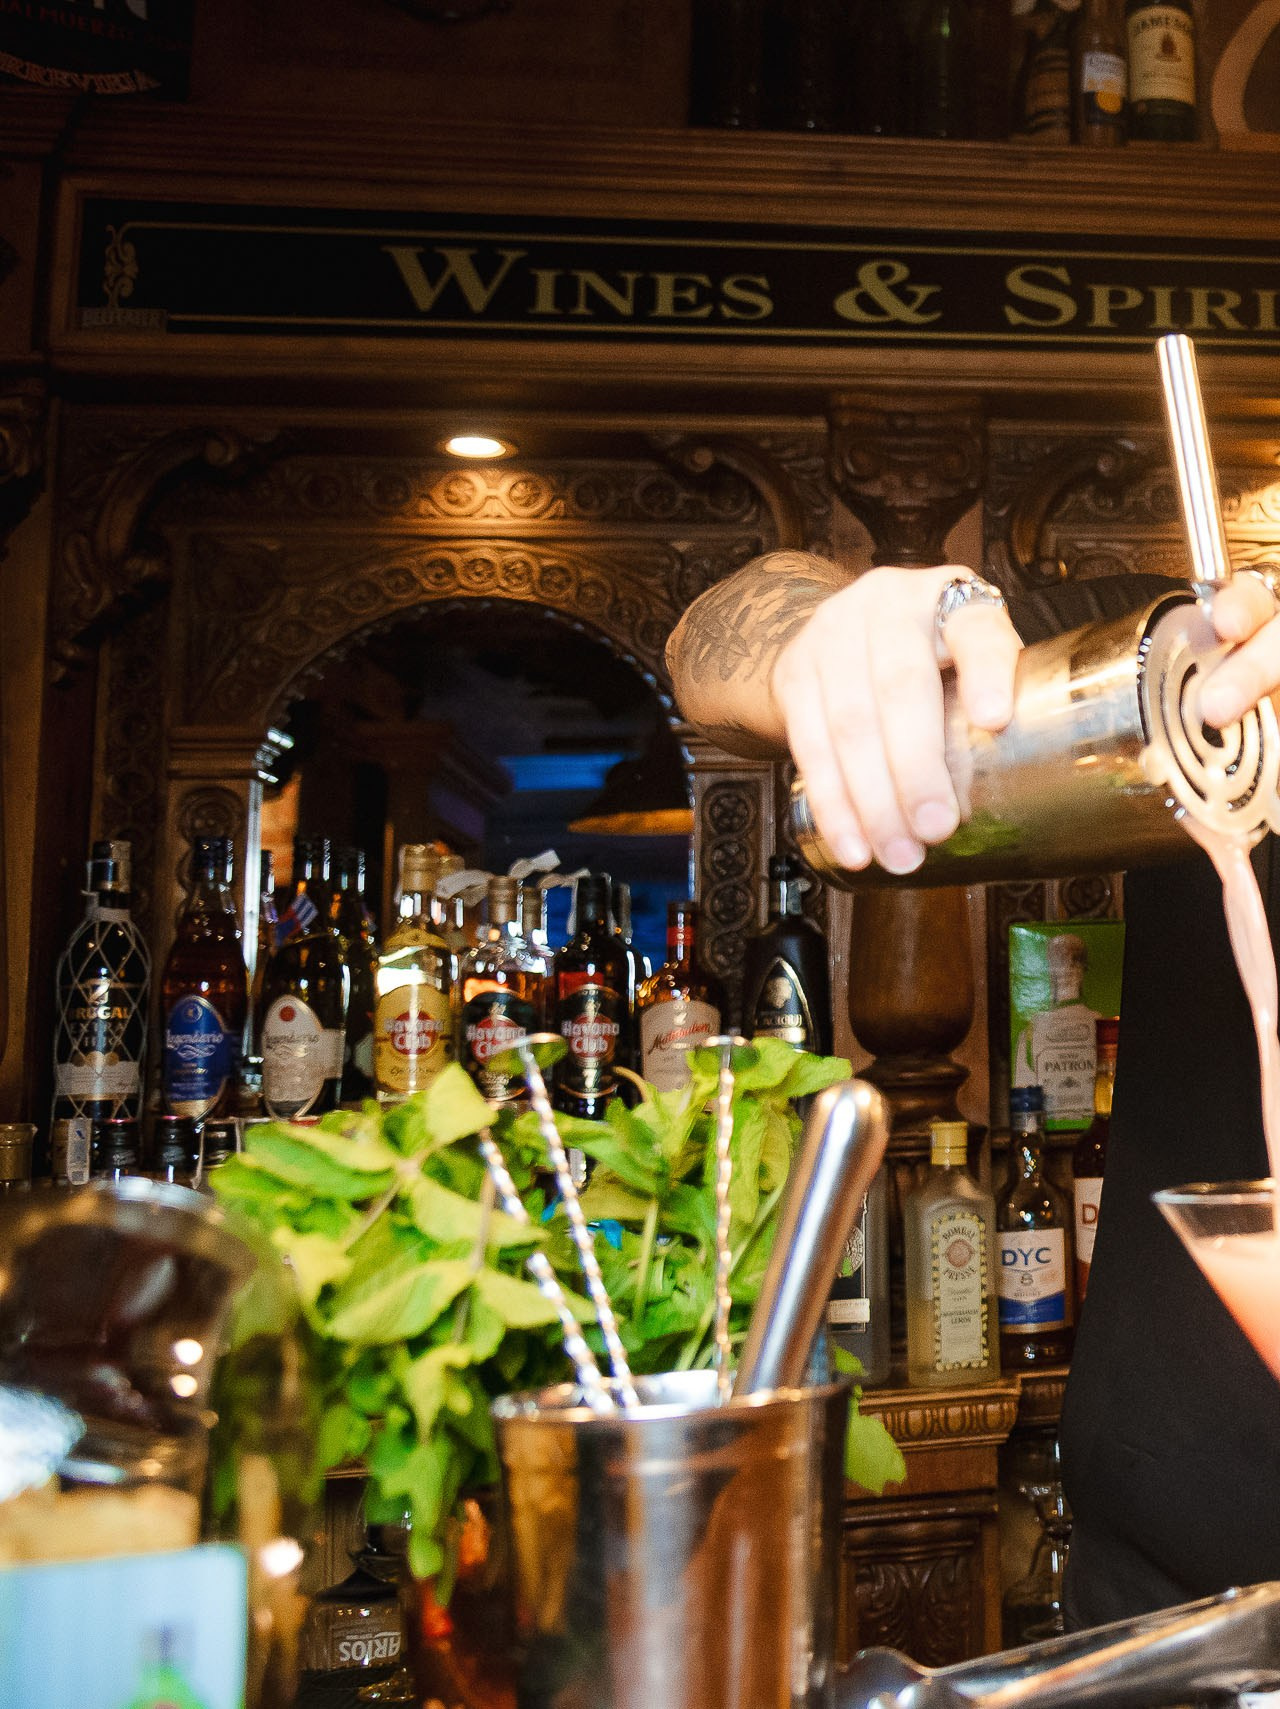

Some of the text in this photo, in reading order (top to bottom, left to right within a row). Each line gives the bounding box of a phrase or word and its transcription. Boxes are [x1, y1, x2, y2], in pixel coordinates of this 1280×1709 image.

[382, 245, 775, 320] WINES
[834, 257, 940, 324] &
[466, 1023, 527, 1042] Havana
[561, 1020, 620, 1037] Havana
[166, 1029, 224, 1051] Legendario
[571, 1036, 609, 1054] Club
[1001, 1247, 1053, 1267] DYC
[338, 1636, 401, 1662] ARIOS
